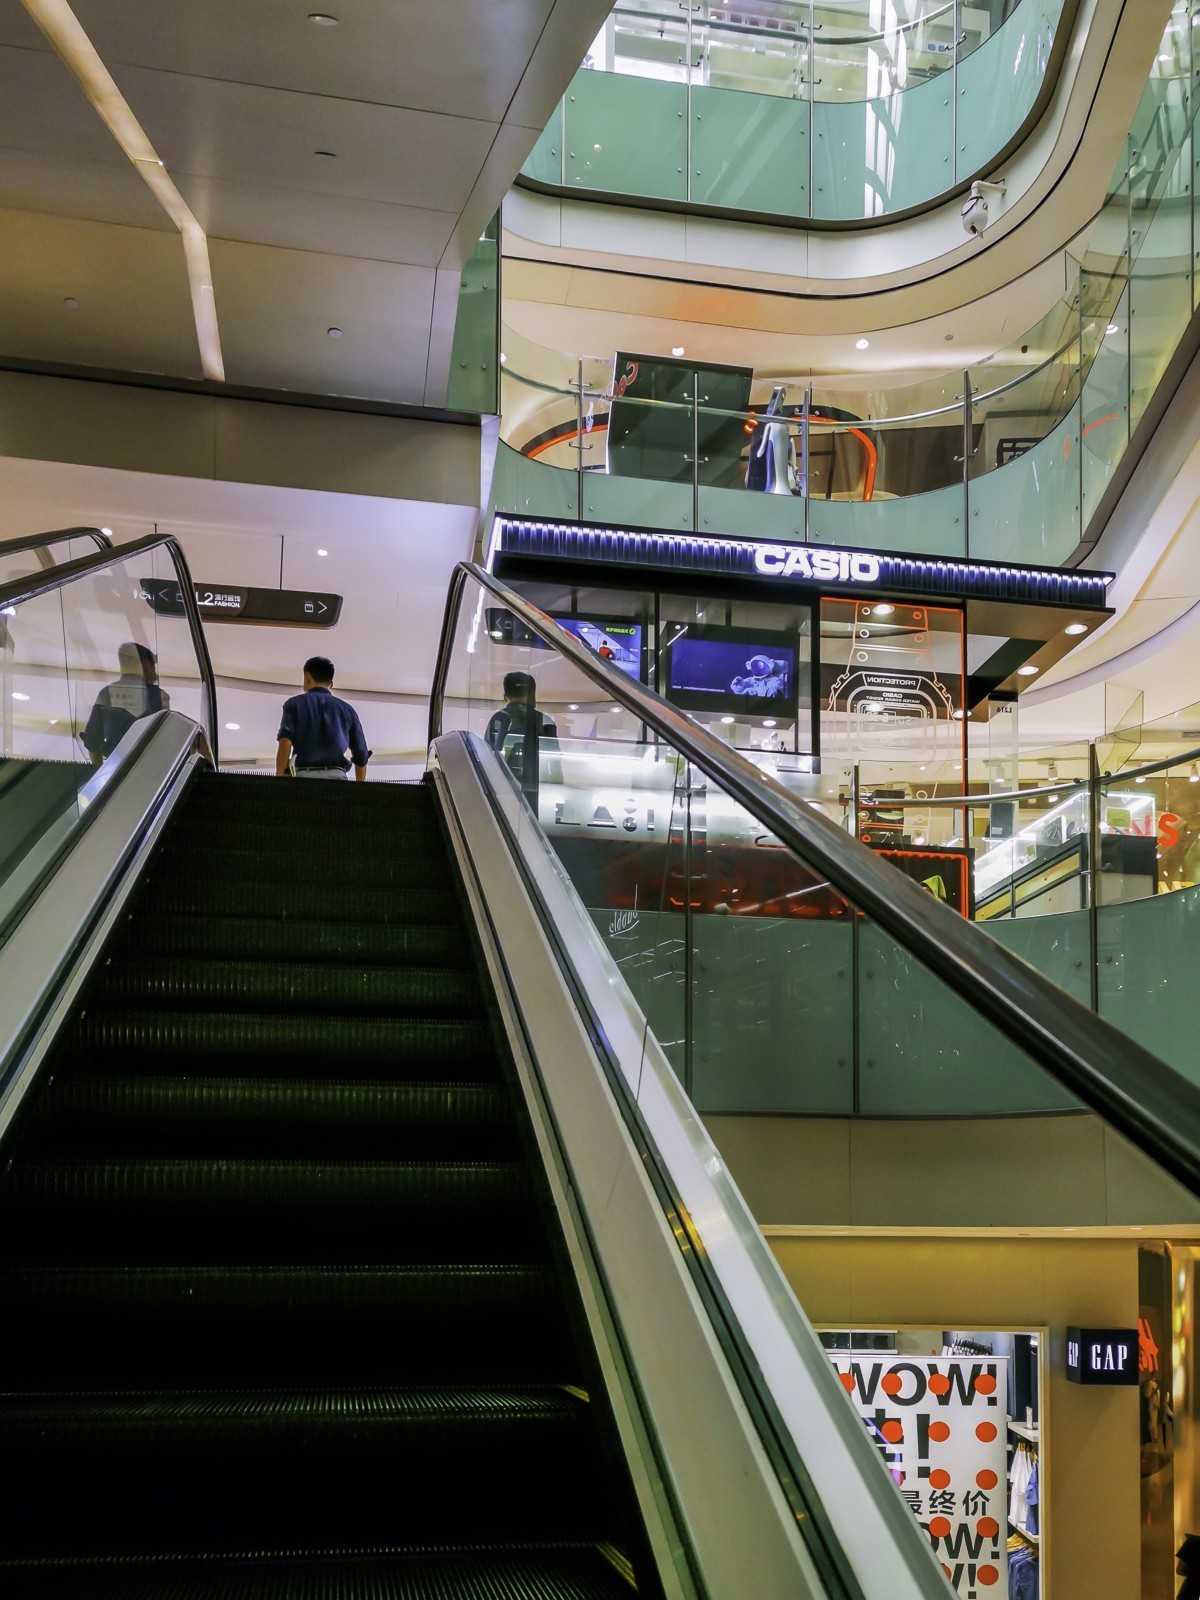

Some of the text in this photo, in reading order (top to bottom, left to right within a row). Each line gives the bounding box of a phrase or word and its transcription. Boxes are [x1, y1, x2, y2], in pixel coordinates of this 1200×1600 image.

[755, 546, 879, 582] CASIO
[195, 591, 214, 606] L2
[214, 600, 241, 608] FASHION
[1091, 1344, 1128, 1371] GAP
[833, 1362, 998, 1406] WOW!
